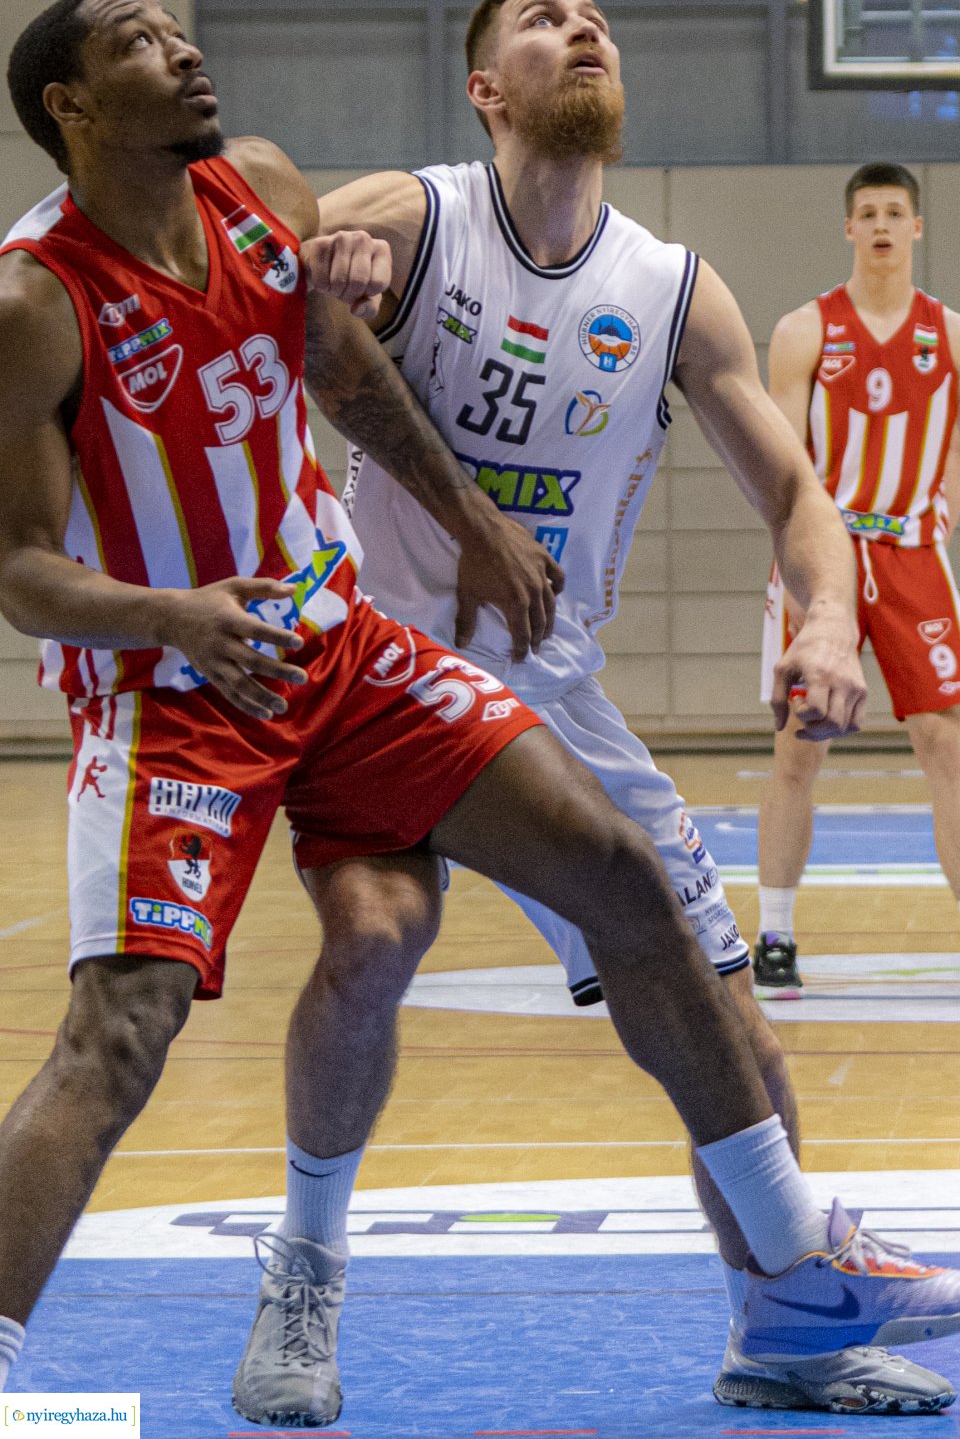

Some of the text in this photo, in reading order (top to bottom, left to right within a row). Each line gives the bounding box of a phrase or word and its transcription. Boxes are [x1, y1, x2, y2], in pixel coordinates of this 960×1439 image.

[445, 283, 482, 316] JAKO
[128, 361, 167, 394] MOL
[197, 333, 290, 445] 53
[866, 367, 893, 413] 9
[456, 358, 546, 445] 35
[373, 642, 404, 678] MOL
[929, 643, 957, 679] 9
